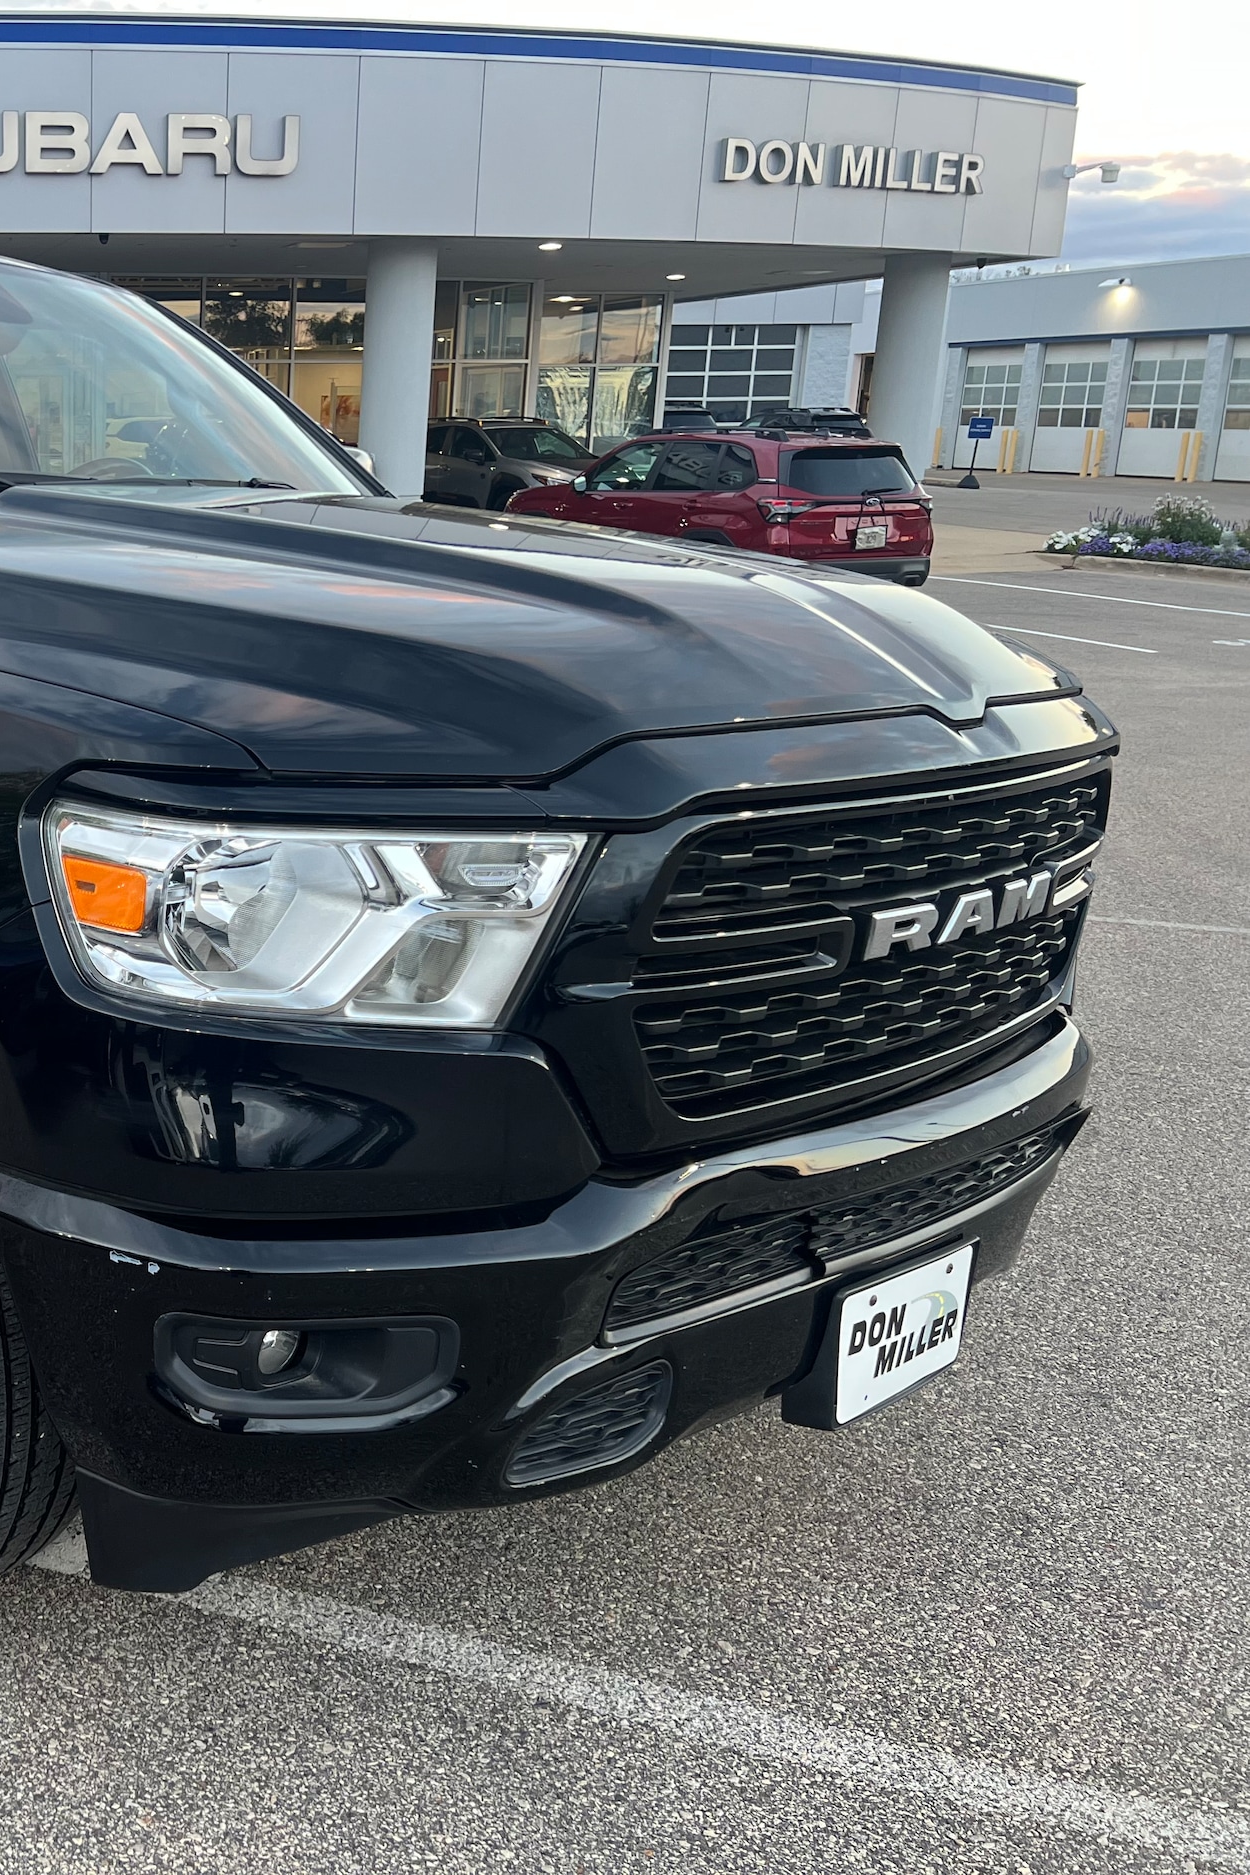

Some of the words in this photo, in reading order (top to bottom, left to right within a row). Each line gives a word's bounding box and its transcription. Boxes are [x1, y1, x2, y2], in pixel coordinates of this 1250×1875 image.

[721, 137, 826, 185] DON
[834, 144, 985, 195] MILLER
[863, 870, 1052, 961] RAM
[848, 1303, 907, 1356] DON
[873, 1308, 958, 1379] MILLER
